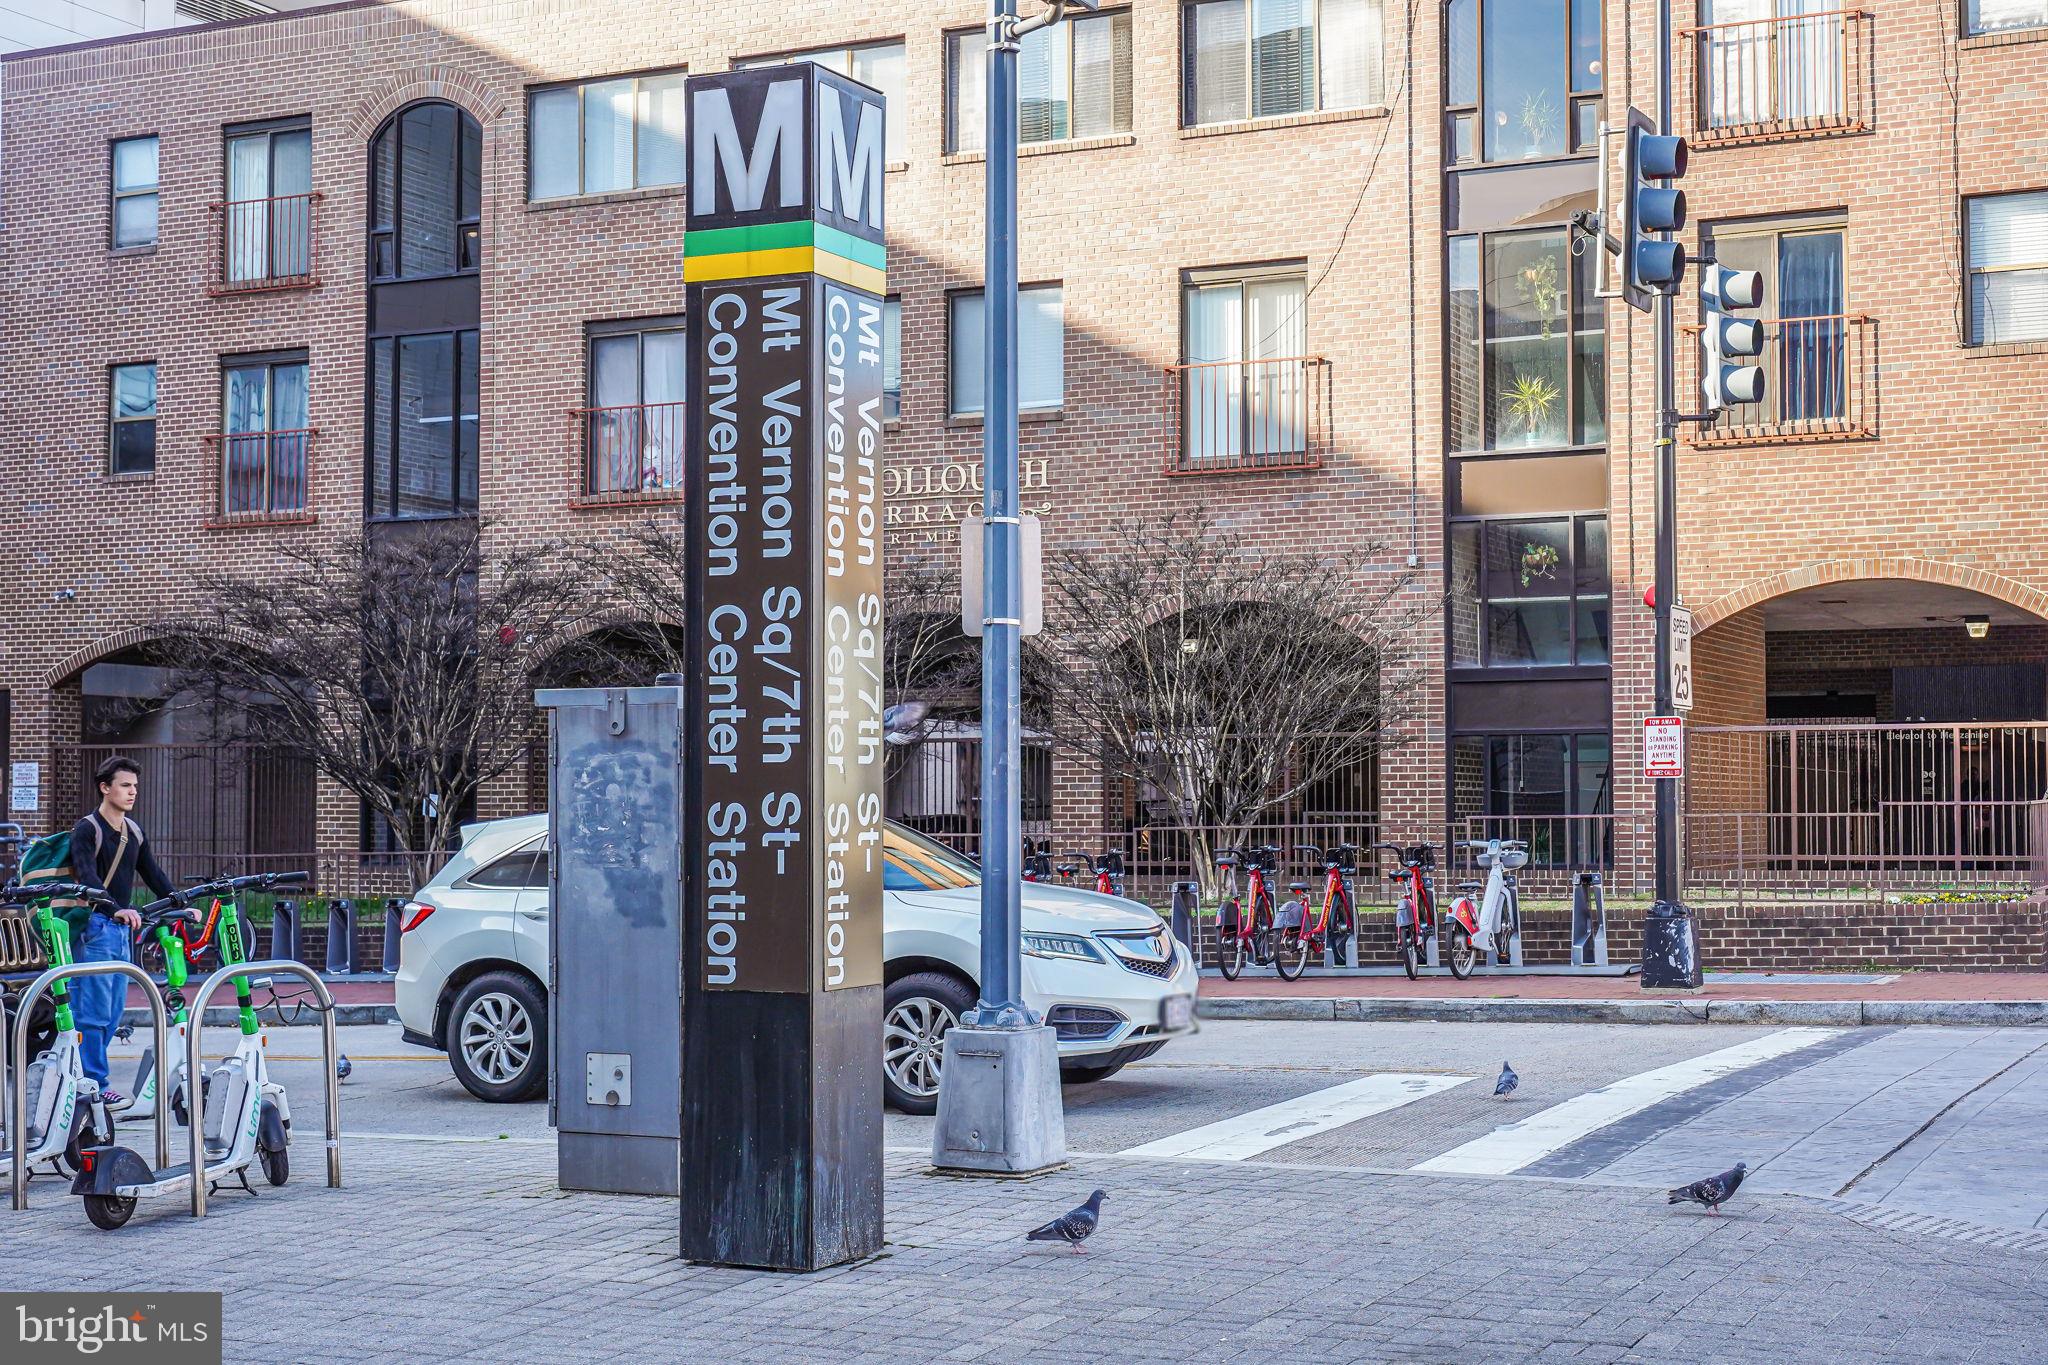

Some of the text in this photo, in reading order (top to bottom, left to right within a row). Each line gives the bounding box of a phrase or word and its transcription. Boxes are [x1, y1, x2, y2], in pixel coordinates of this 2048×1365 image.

[693, 79, 803, 216] M
[819, 81, 883, 231] M
[883, 459, 1050, 496] OLLOUH
[753, 287, 801, 875] Mt Vernon Sq/7th St-
[853, 302, 880, 873] Mt Vernon Sq/7th St-
[707, 293, 747, 985] Convention Center Station
[1672, 617, 1689, 635] SPEED
[827, 295, 850, 986] Convention Center Station
[1674, 638, 1687, 653] LIMIT
[1674, 663, 1689, 701] 25
[1658, 727, 1668, 735] NO
[1661, 718, 1676, 726] AWAY
[1886, 731, 1990, 740] Elevator to Mezanine
[1649, 735, 1677, 743] STANDING
[1654, 743, 1679, 751] PARKING
[1652, 751, 1676, 759] ANYTIME
